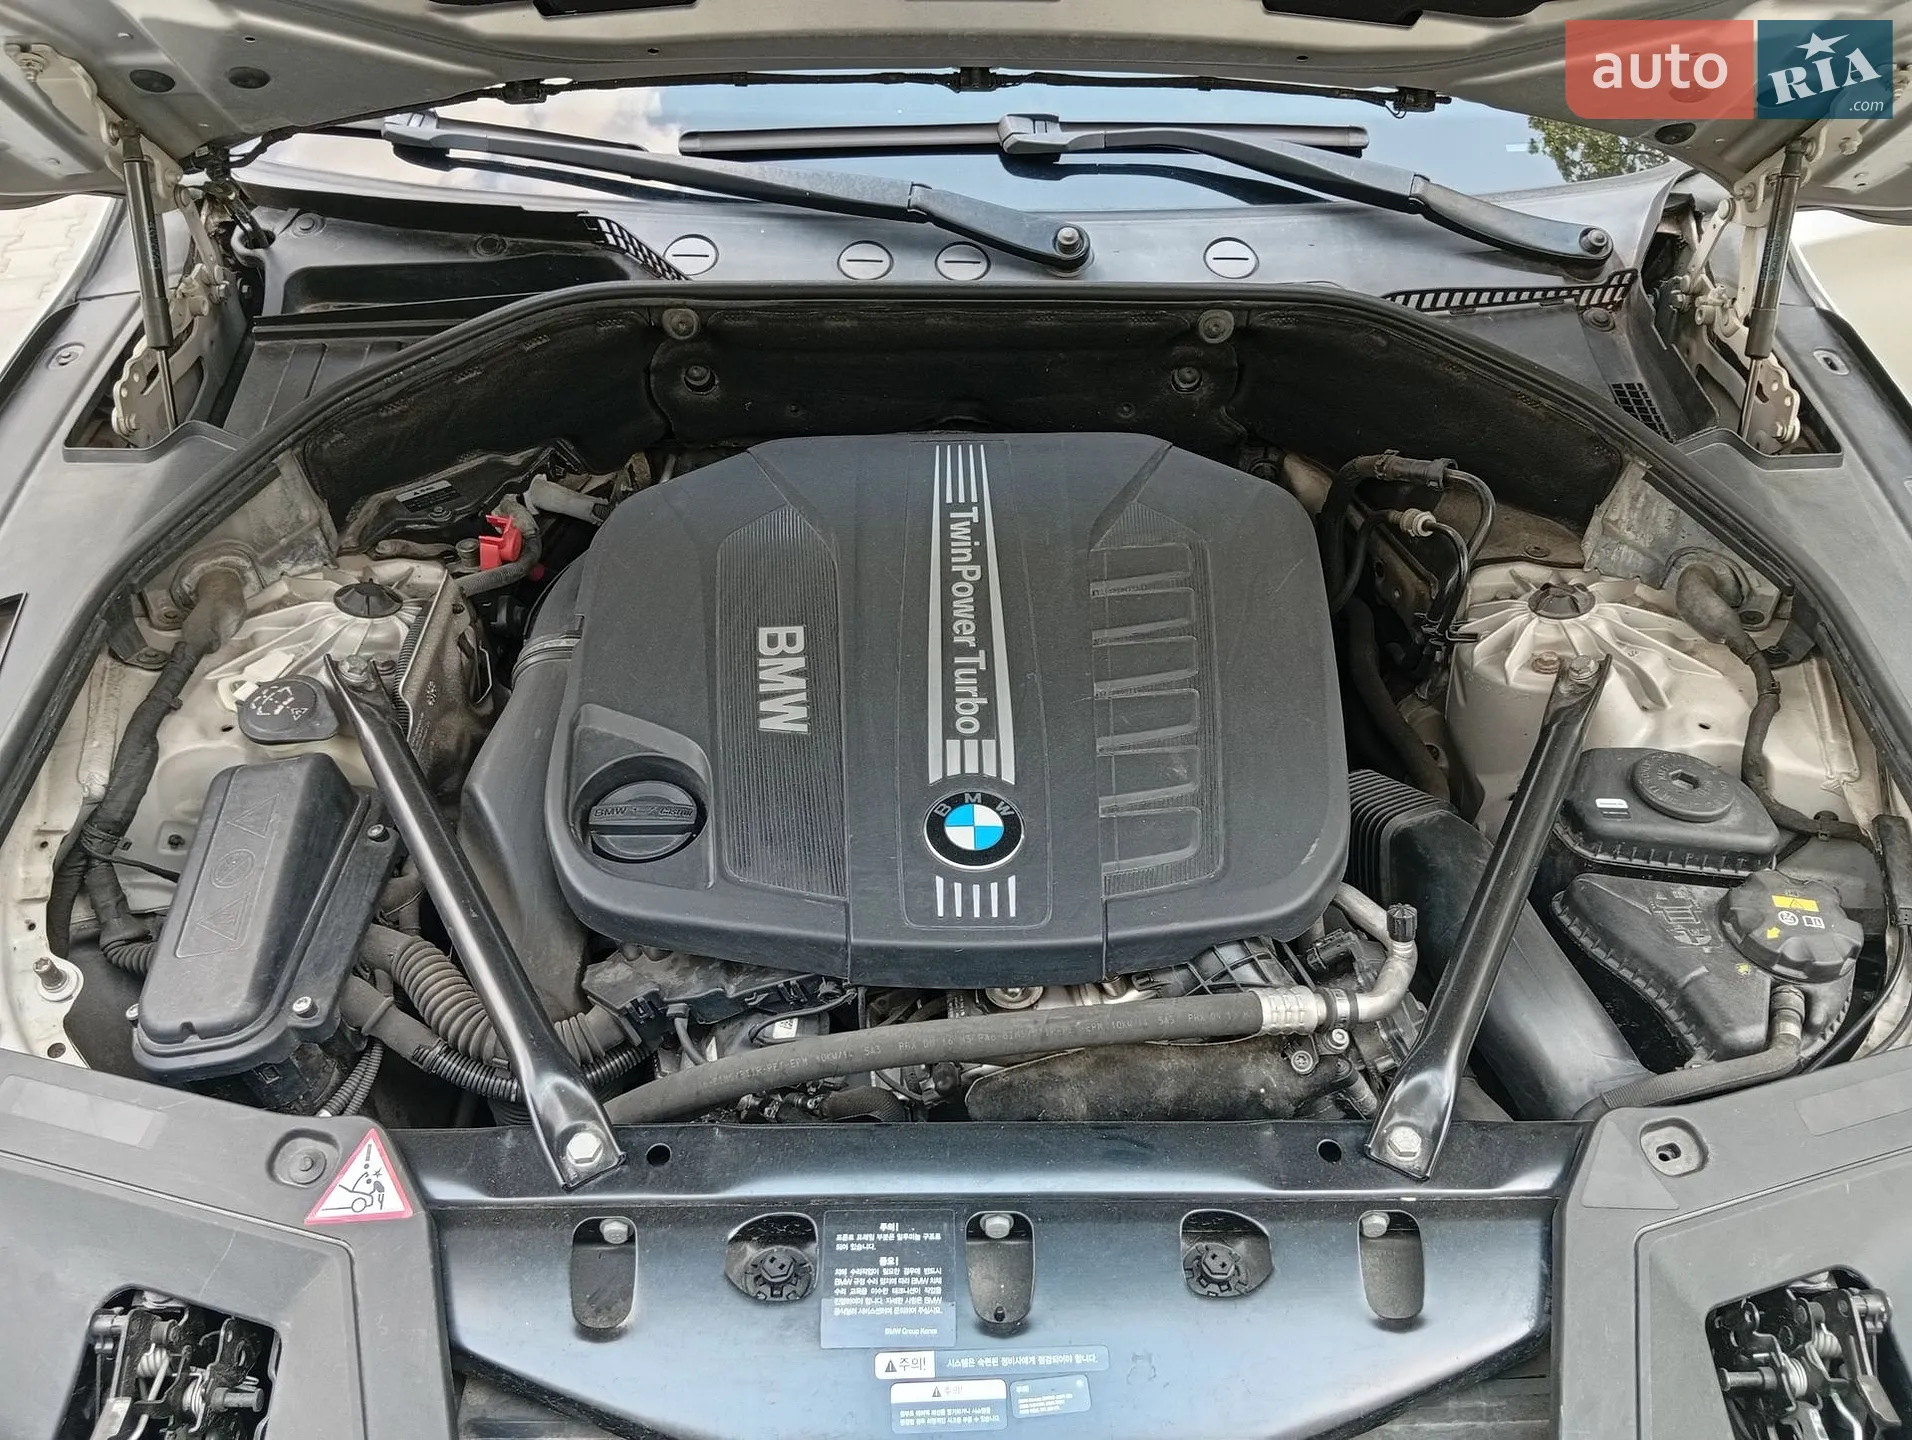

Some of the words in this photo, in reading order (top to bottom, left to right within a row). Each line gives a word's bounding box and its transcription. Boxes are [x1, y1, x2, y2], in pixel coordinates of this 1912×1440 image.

[949, 506, 982, 647] TwinPower
[758, 625, 808, 733] BMW
[953, 649, 988, 734] Turbo
[594, 807, 627, 817] BMW
[933, 792, 1015, 817] BMW
[899, 1357, 926, 1371] 주의!
